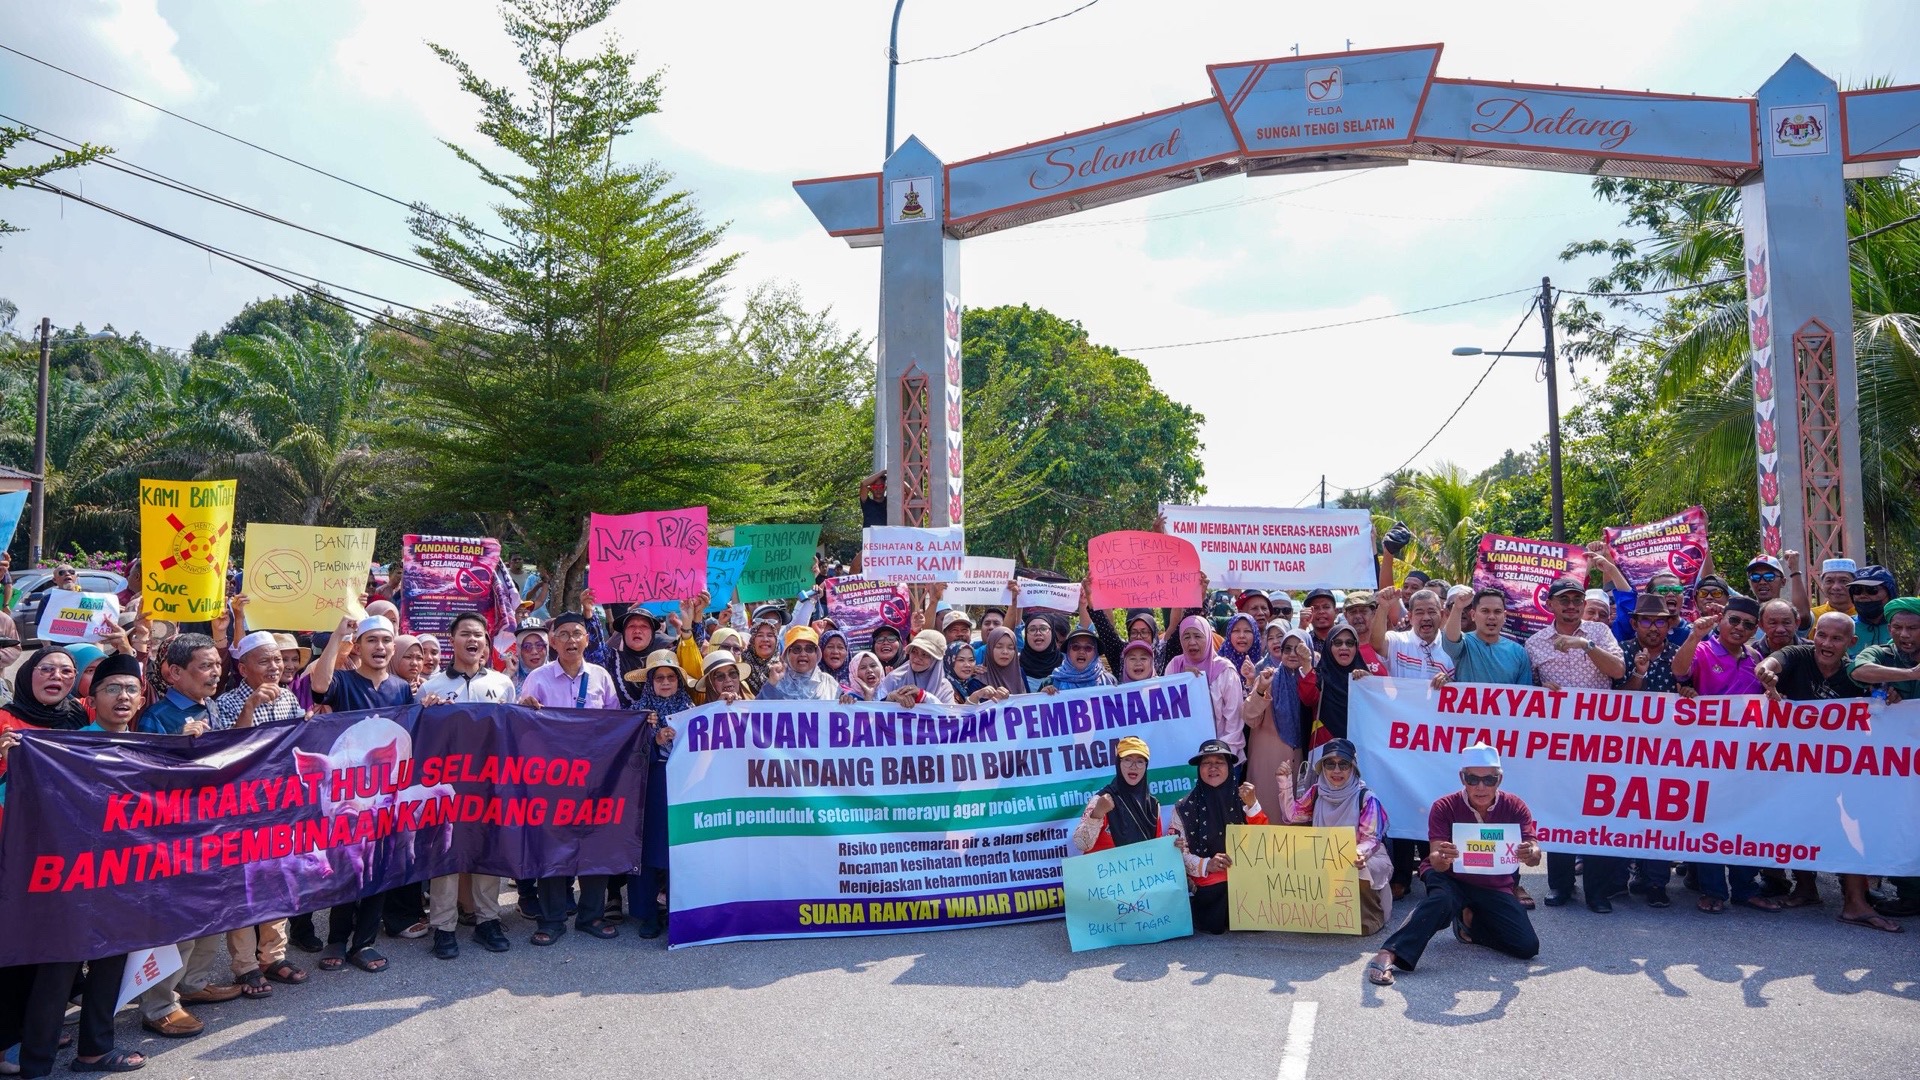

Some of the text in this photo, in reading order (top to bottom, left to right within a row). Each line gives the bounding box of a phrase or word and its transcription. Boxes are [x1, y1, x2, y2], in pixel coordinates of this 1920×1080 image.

[1307, 105, 1343, 116] FELDA
[1256, 117, 1395, 140] SUNGAI TENGI SELATAN
[1471, 98, 1638, 150] Datang
[1029, 128, 1181, 190] Selamat
[142, 485, 234, 508] KAMI BANTAH
[1173, 521, 1360, 537] KAMI MEMBANTAH SEKERAS-KERASNYA
[1665, 524, 1691, 535] BABI
[315, 533, 369, 551] BANTAH
[595, 517, 708, 562] NO PIG
[864, 541, 962, 551] KESIHATAN & ALAM
[1096, 537, 1180, 554] WE FIRMLY
[1201, 541, 1332, 555] PEMBINAAN KANDANG BABI
[1494, 539, 1564, 559] BANTAH
[1623, 536, 1681, 550] BESAR-BESARAN
[414, 544, 484, 556] KANDANG BABI
[421, 553, 474, 561] BESAR-BESARAN
[765, 548, 791, 563] BABI
[313, 560, 367, 573] PEMBINAAN
[864, 556, 962, 571] SEKITAR KAMI
[1096, 555, 1180, 576] OPPOSE PIG
[1228, 560, 1306, 572] DI BUKIT TAGAR
[1487, 553, 1568, 571] KANDANG BABI
[1494, 564, 1555, 577] BESAR-BESARAN
[146, 572, 188, 596] Save
[741, 565, 802, 586] ENCEMARAN
[888, 574, 936, 582] TERANCAM
[973, 570, 1009, 579] BANTAH
[1098, 572, 1200, 591] FARMING IN BUKIT
[611, 568, 695, 602] FARM
[835, 581, 876, 593] KANDANG
[843, 588, 892, 599] BESAR-BESARAN
[79, 601, 104, 610] KAMI
[153, 597, 180, 613] Our
[60, 610, 93, 622] TOLAK
[688, 684, 1191, 753] RAYUAN BANTAHAN PEMBINAAN
[1437, 686, 1871, 732] RAKYAT HULU SELANGOR
[1389, 721, 1920, 777] BANTAH PEMBINAAN KANDAN
[748, 736, 1125, 788] KANDANG BABI DI BUKIT TAGA
[103, 753, 591, 832] KAMI RAKYAT HULU SELANGOR
[1581, 774, 1710, 824] BABI
[694, 808, 732, 830] Kami
[735, 807, 815, 828] penduduk
[817, 805, 889, 824] setempat
[892, 804, 950, 821] merayu
[953, 802, 985, 819] agar
[988, 796, 1036, 816] projek
[1037, 793, 1058, 810] ini
[1150, 776, 1191, 794] erana
[27, 795, 626, 893] BANTAH PEMBINAAN KANDANG BABI
[838, 828, 1068, 856] Risiko pencemaran air & alam sekitar
[1481, 832, 1504, 840] KAMI
[1232, 832, 1355, 870] KAMI TAK
[1467, 843, 1496, 852] TOLAK
[838, 845, 1068, 875] Ancaman kesihatan kepada komuniti
[1097, 853, 1154, 879] BANTAH
[839, 878, 922, 895] Menjejaskan
[925, 870, 1008, 889] keharmonian
[1088, 870, 1177, 901] MEGA LADANG
[1267, 873, 1323, 902] MAHU
[799, 903, 865, 925] SUARA
[869, 899, 941, 923] RAKYAT
[945, 894, 1011, 918] WAJAR
[1118, 899, 1150, 915] BABI
[1235, 879, 1355, 932] KANDANG BABI
[1089, 915, 1171, 936] BUKIT TAGAR
